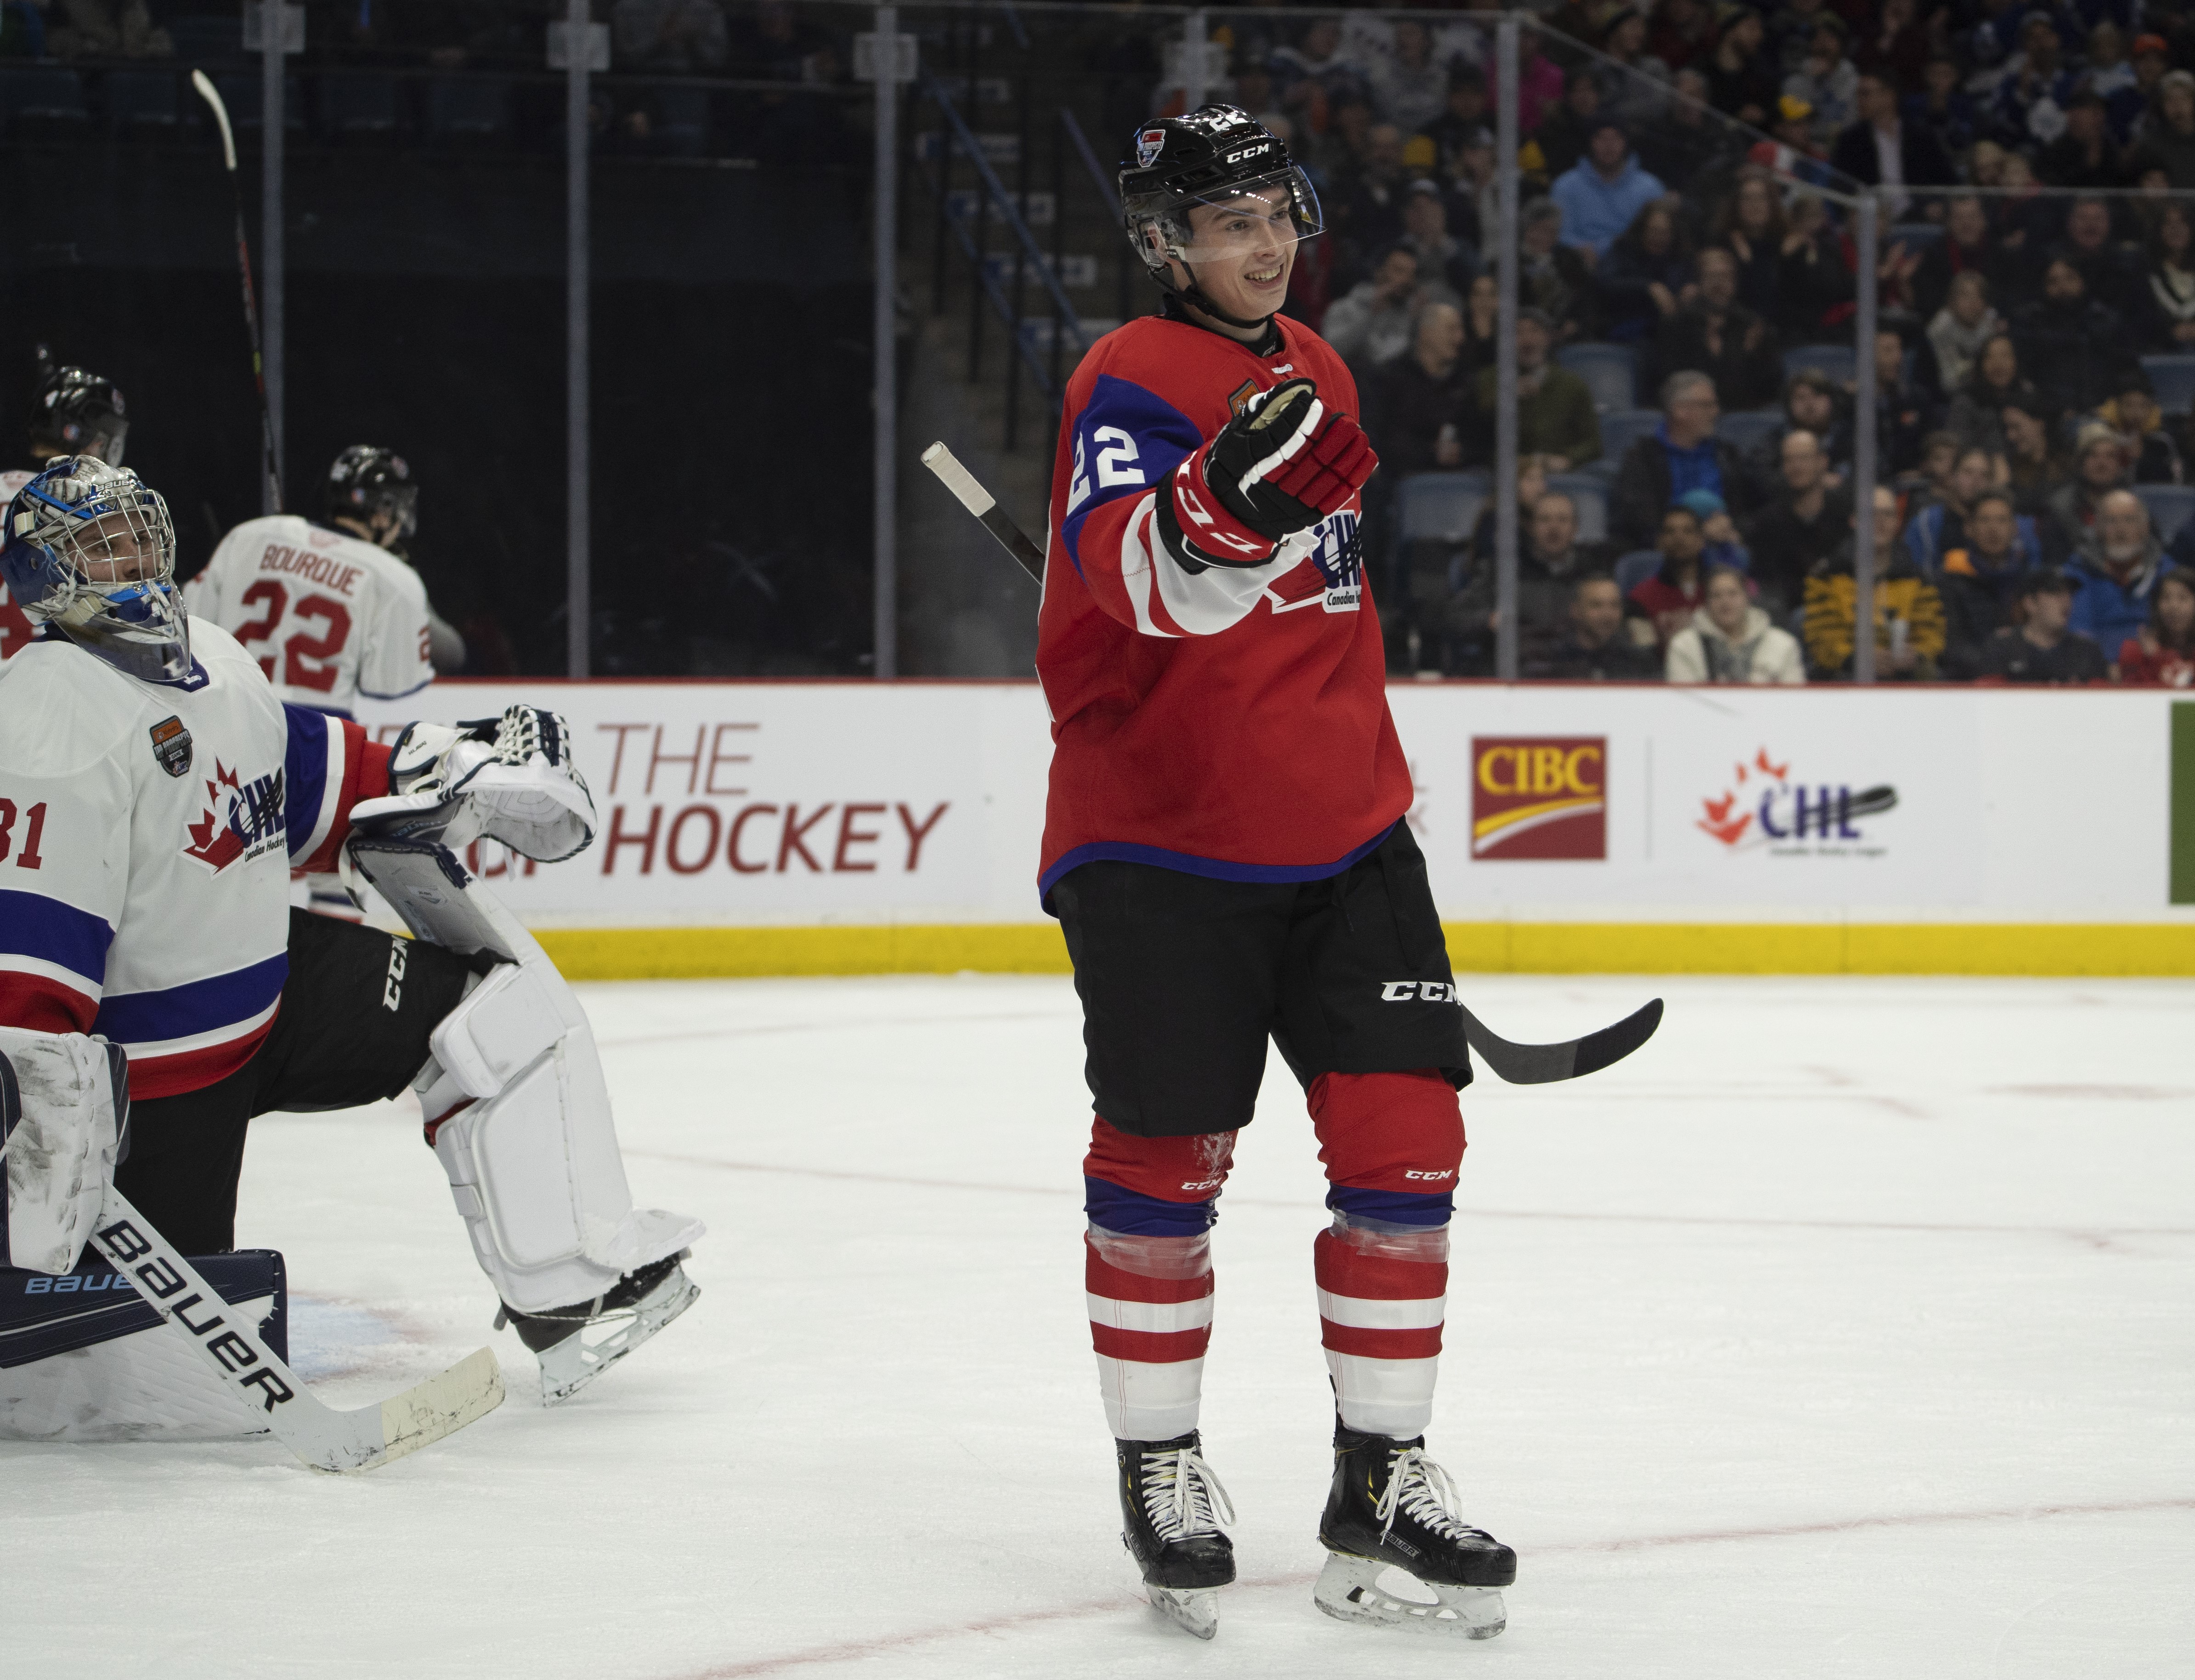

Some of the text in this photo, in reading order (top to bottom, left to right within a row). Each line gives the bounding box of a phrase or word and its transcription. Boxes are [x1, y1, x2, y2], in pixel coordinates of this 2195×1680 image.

[1226, 143, 1269, 164] CCM
[1066, 425, 1146, 517] 22
[259, 543, 365, 596] BOURQUE
[1327, 590, 1355, 606] Canadian
[232, 577, 353, 695] 22
[596, 722, 762, 796] THE
[1477, 746, 1601, 796] CIBC
[229, 774, 285, 849] CHL
[1759, 785, 1861, 840] CHL
[245, 836, 285, 862] Canadian Hockey
[601, 802, 952, 877] HOCKEY
[383, 934, 408, 1012] CCM
[1381, 981, 1462, 1006] CCM
[1181, 1177, 1222, 1190] CCM
[1405, 1169, 1453, 1181] CCM
[25, 1274, 135, 1294] BAUE
[96, 1220, 295, 1414] BAUER
[1384, 1531, 1416, 1556] BAUER
